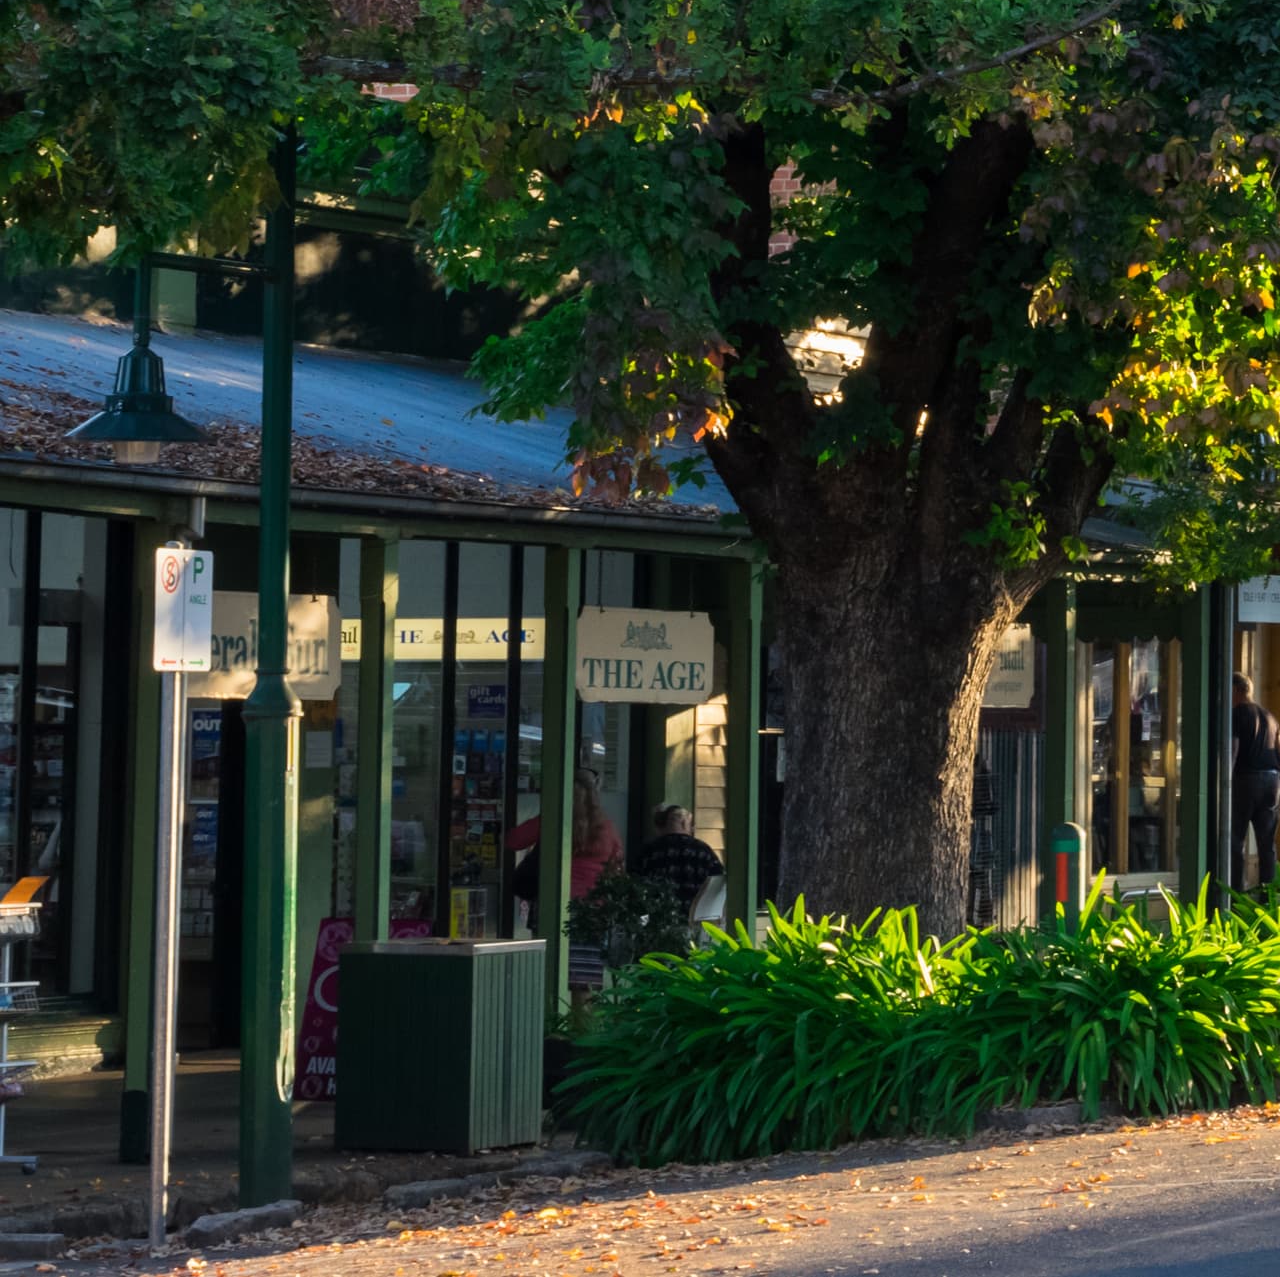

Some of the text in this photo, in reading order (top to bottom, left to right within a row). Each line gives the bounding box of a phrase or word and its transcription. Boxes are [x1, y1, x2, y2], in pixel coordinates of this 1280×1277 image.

[193, 557, 204, 583] P
[189, 595, 206, 604] ANGLE
[340, 626, 357, 644] ail
[394, 630, 423, 643] HE
[288, 623, 329, 675] un
[582, 658, 705, 691] THE AGE
[469, 683, 490, 700] gift
[477, 693, 506, 705] cards
[193, 719, 222, 732] OUT
